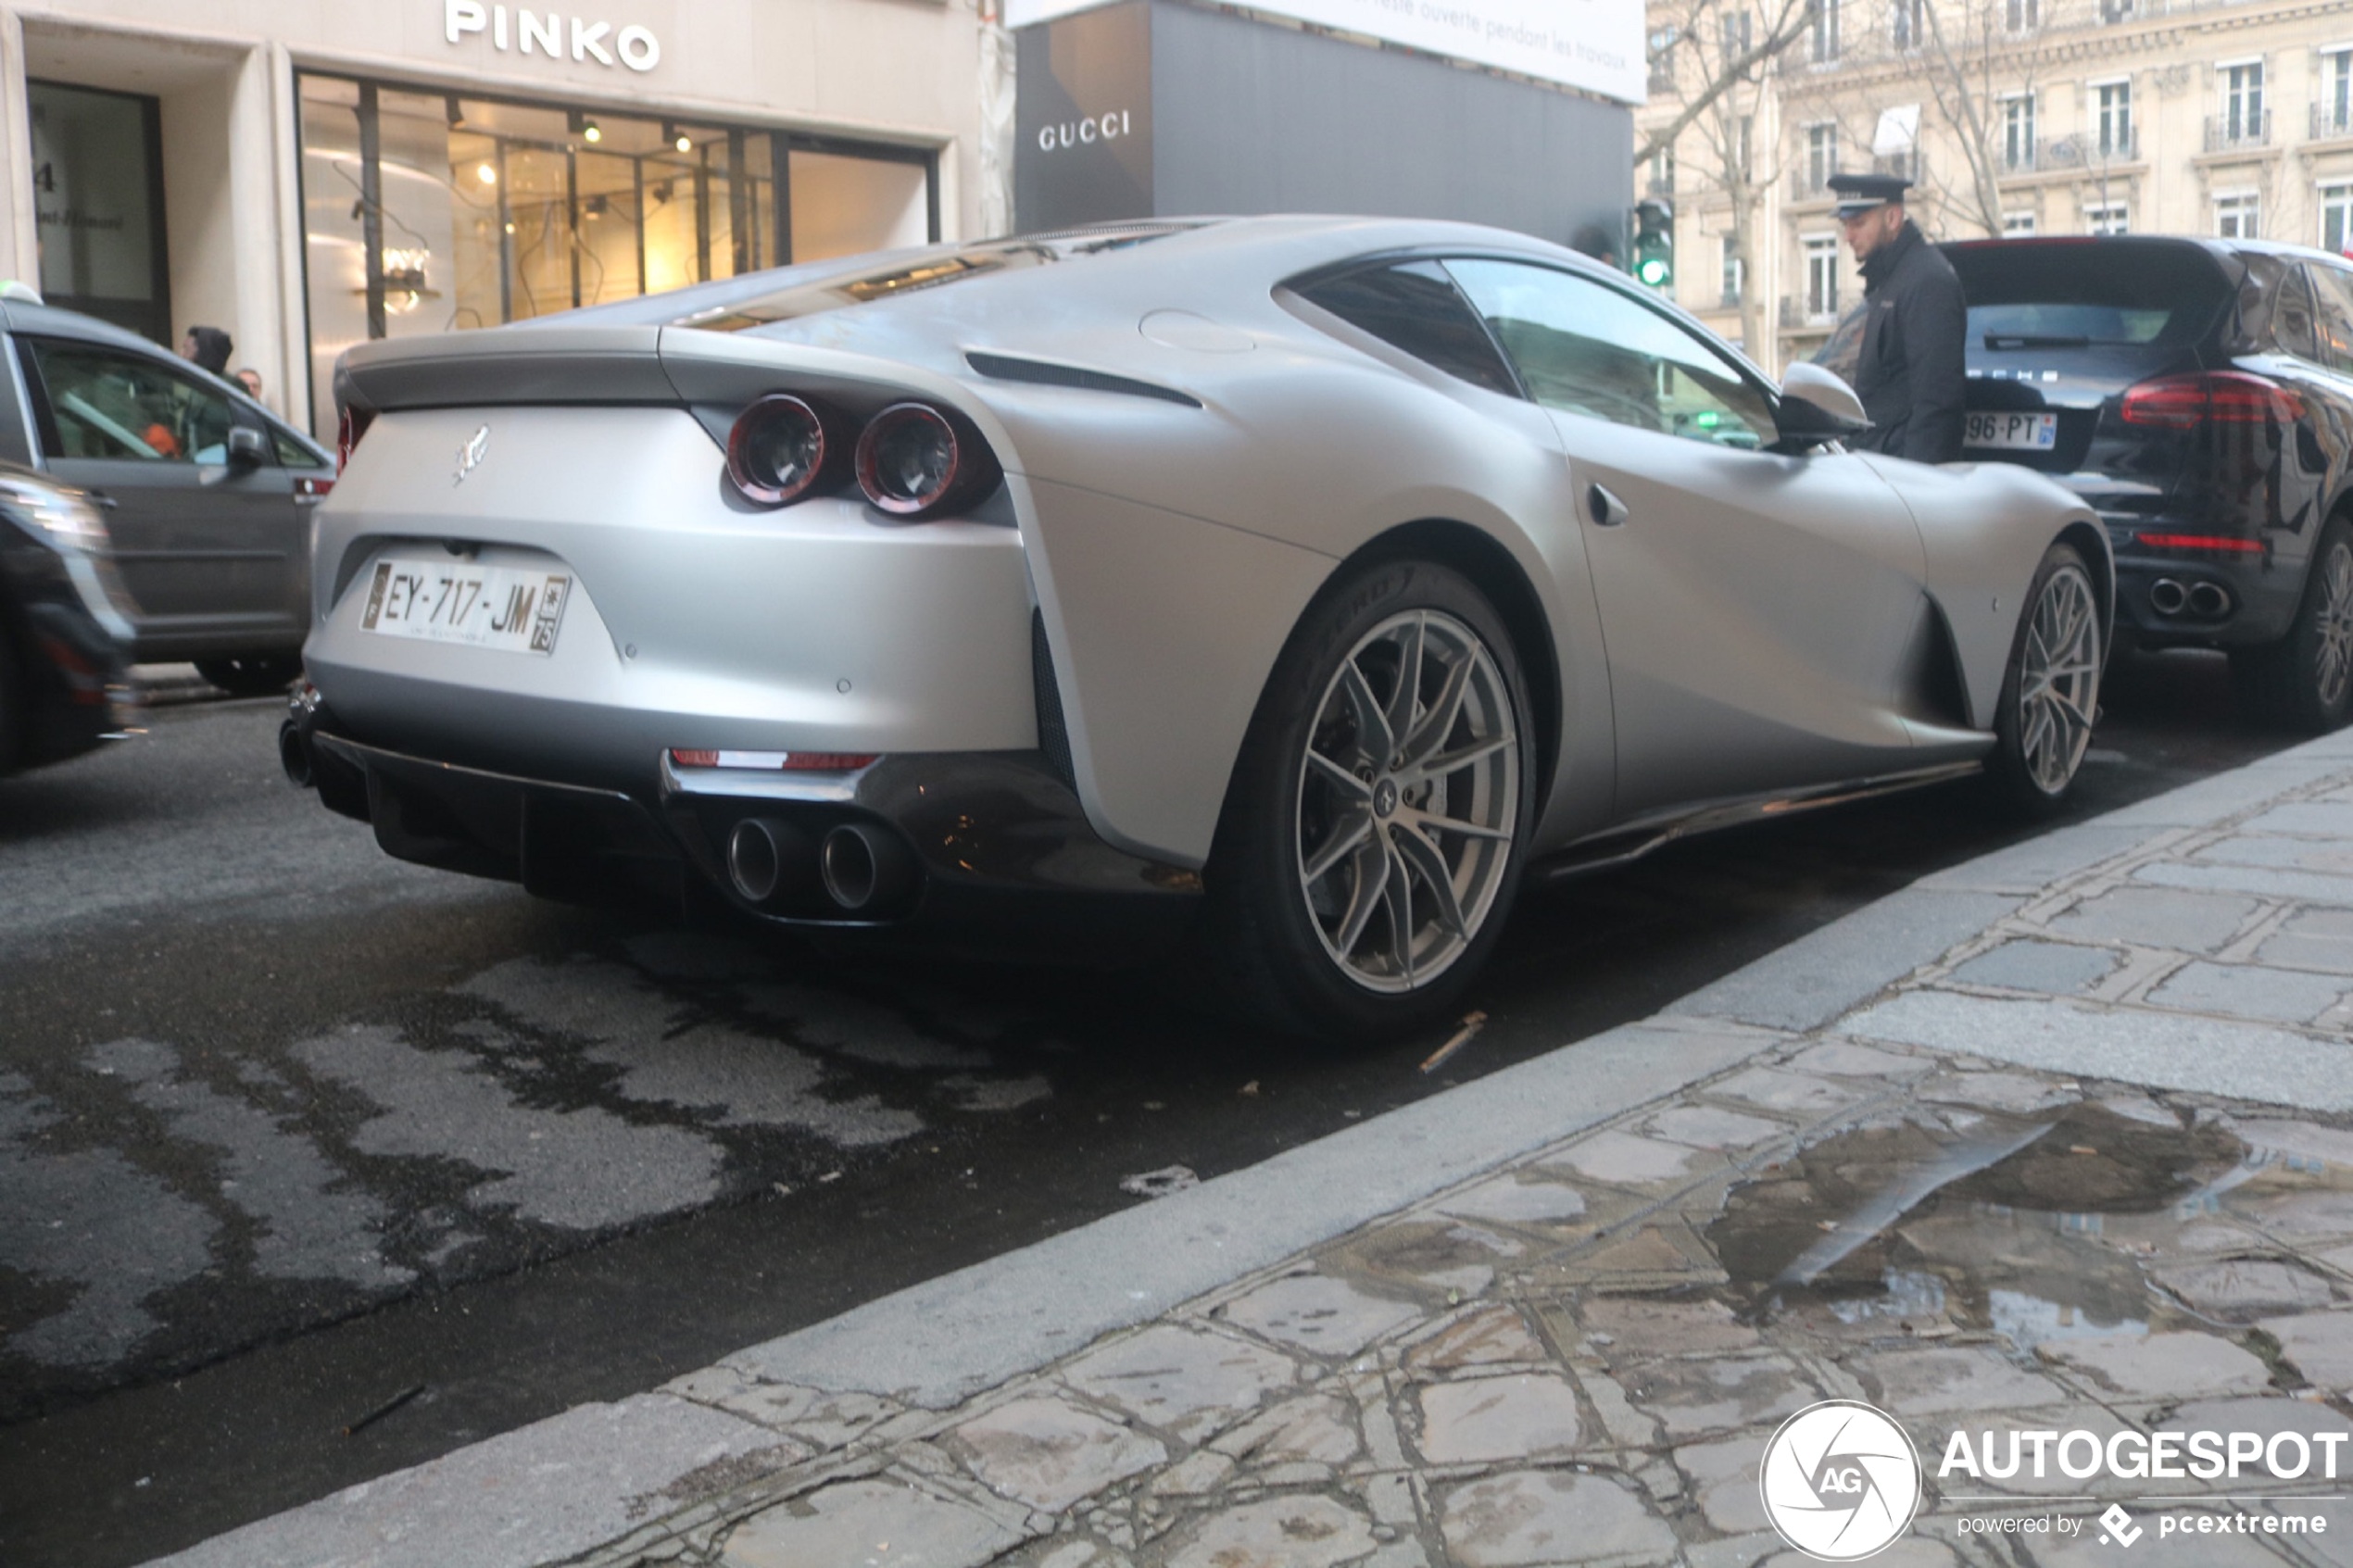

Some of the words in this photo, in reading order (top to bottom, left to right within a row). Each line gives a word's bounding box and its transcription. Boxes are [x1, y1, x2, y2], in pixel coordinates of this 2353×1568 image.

[445, 0, 661, 72] PINKO
[1420, 3, 1481, 33] ouverte
[1486, 18, 1548, 51] pendant
[1553, 30, 1572, 56] les
[1577, 41, 1627, 69] travaux
[1038, 109, 1130, 152] GUCCI
[385, 574, 536, 635] EY-717-JM
